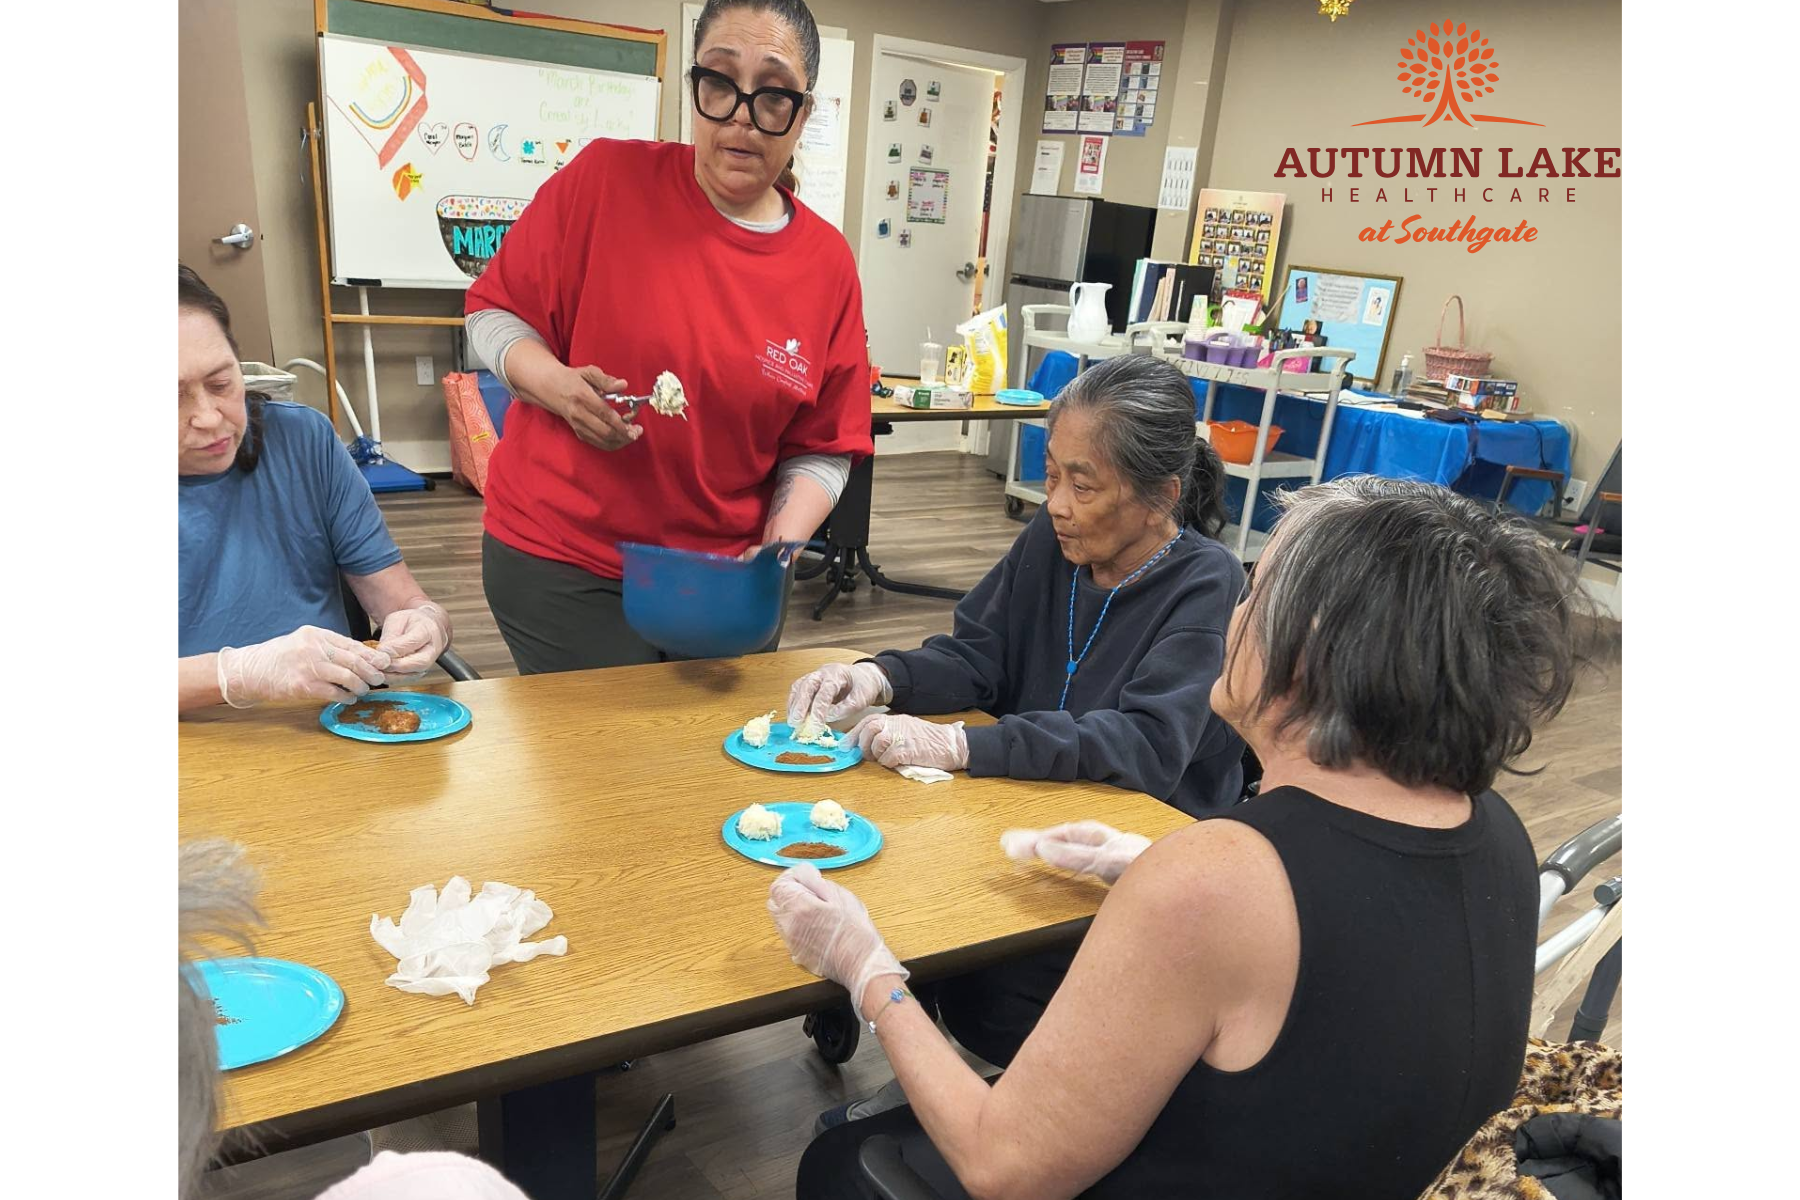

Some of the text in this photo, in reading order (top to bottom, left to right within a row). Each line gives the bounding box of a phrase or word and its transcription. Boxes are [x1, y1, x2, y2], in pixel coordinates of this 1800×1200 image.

[452, 223, 512, 259] MARC
[766, 345, 809, 377] RED OAK
